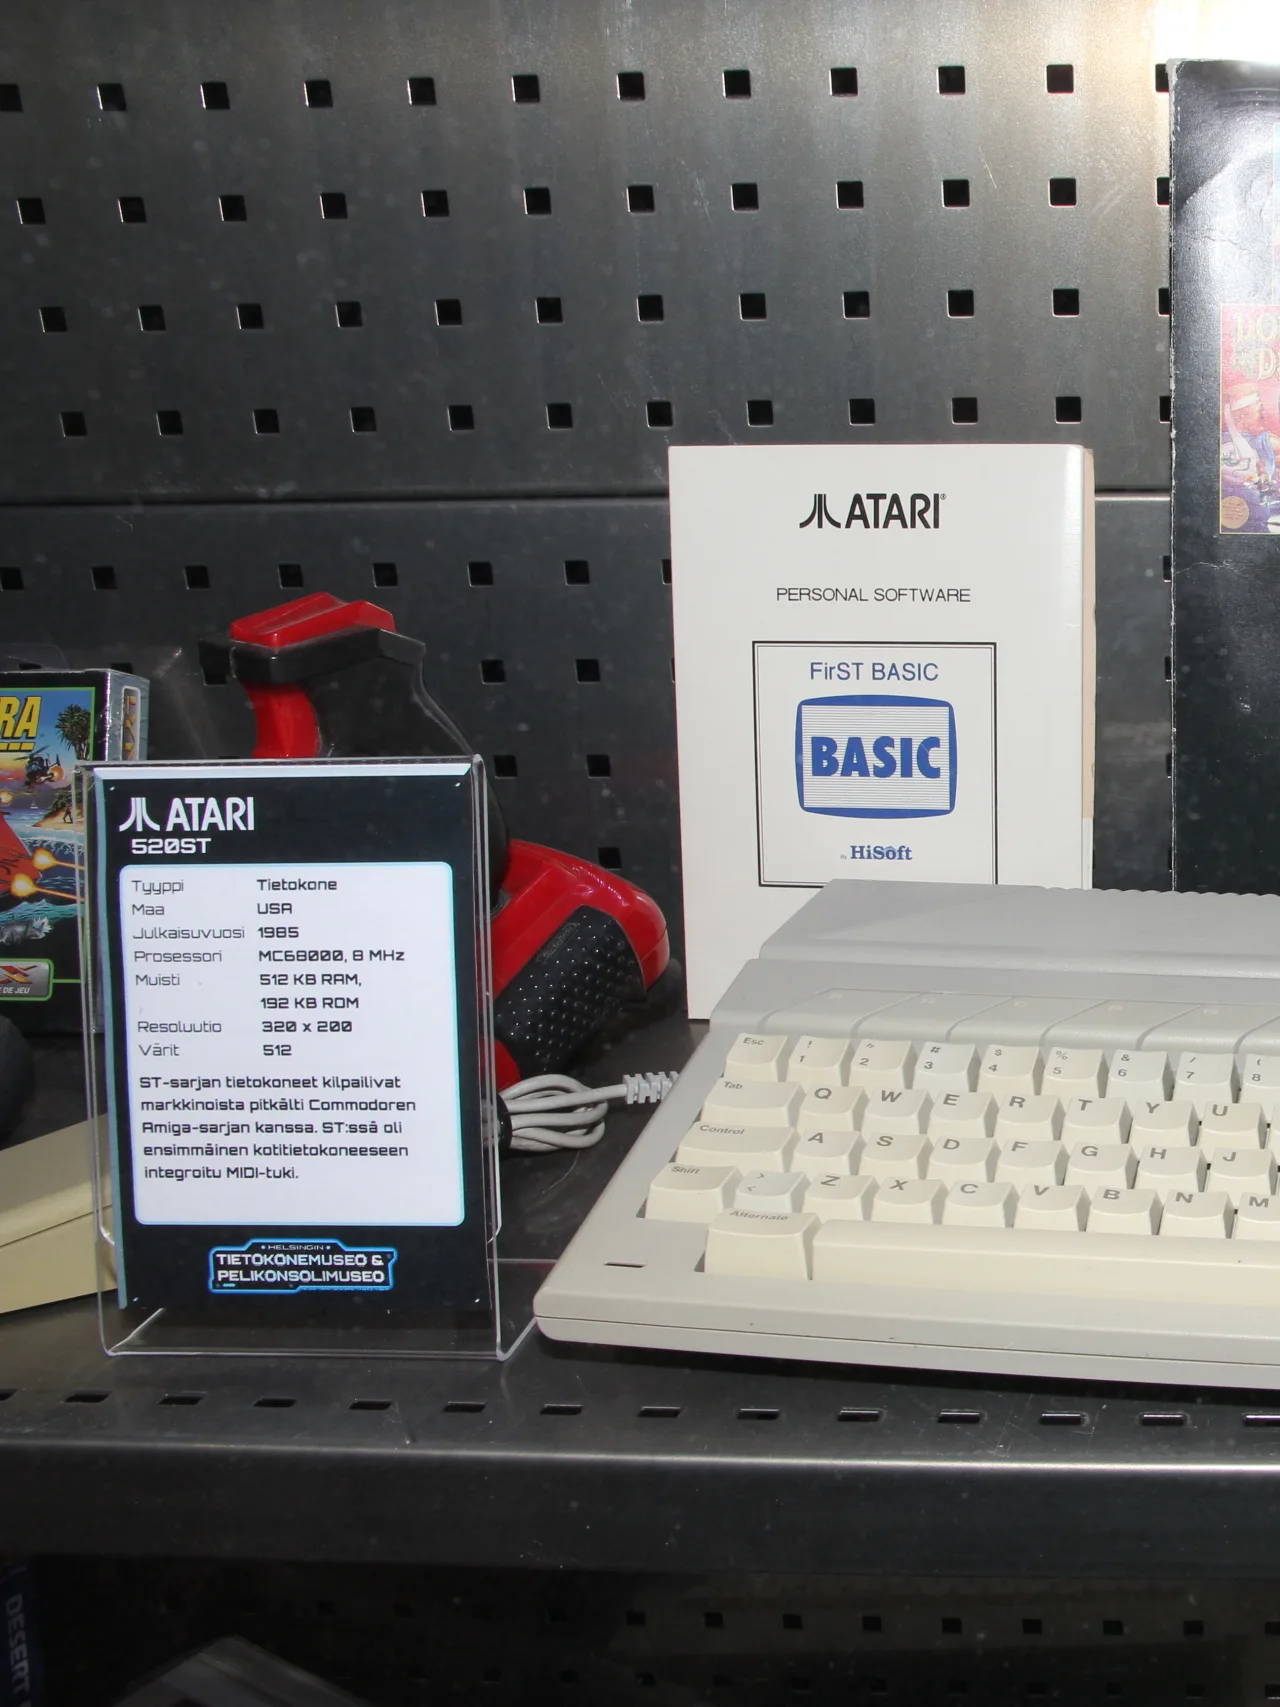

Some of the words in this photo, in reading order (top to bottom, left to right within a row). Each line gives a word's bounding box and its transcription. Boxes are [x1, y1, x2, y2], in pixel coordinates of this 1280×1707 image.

[777, 588, 868, 601] PERSONAL
[874, 588, 970, 602] SOFTWARE
[810, 662, 864, 680] FirST
[871, 663, 939, 681] BASIC
[811, 737, 940, 778] BASIC
[166, 797, 255, 831] ATARI
[132, 838, 212, 854] 520ST
[850, 845, 912, 860] HiSoft
[132, 880, 183, 895] Tyyppi
[257, 879, 337, 890] Tietokone
[132, 904, 164, 915] Maa
[258, 903, 292, 914] USA
[133, 927, 244, 939] Julkaisuvuosi
[258, 927, 299, 938] 1985
[134, 950, 222, 962] Prosessori
[259, 950, 347, 963] MC68000,
[353, 950, 363, 961] 8
[370, 950, 404, 961] MHz
[136, 974, 180, 986] Muisti
[260, 974, 288, 985] 512
[294, 974, 316, 985] KB
[322, 974, 361, 986] RAM,
[261, 998, 289, 1009] 192
[295, 997, 317, 1008] KB
[322, 997, 359, 1008] ROM
[138, 1021, 222, 1032] Resoluutio
[262, 1021, 297, 1032] 320
[303, 1023, 311, 1032] x
[317, 1021, 352, 1032] 200
[743, 1037, 764, 1045] Esc
[139, 1043, 179, 1056] Värit
[263, 1045, 292, 1056] 512
[860, 1058, 869, 1066] 2
[924, 1061, 933, 1069] 3
[989, 1064, 997, 1072] 4
[1187, 1071, 1194, 1079] 7
[140, 1077, 221, 1091] ST-sarjan
[226, 1076, 318, 1088] tietokoneet
[323, 1076, 401, 1091] kilpailivat
[725, 1081, 742, 1089] Tab
[814, 1088, 832, 1099] Q
[882, 1090, 902, 1102] W
[141, 1099, 244, 1110] markkinoista
[250, 1098, 304, 1113] pitkälti
[309, 1099, 415, 1111] Commodoren
[943, 1094, 960, 1106] E
[1009, 1096, 1025, 1108] R
[1078, 1099, 1093, 1111] T
[1146, 1102, 1160, 1114] Y
[1212, 1104, 1228, 1116] U
[142, 1121, 250, 1136] Amiga-sarjan
[255, 1121, 317, 1133] kanssa.
[322, 1121, 378, 1133] ST:ssä
[384, 1122, 402, 1133] oli
[700, 1125, 745, 1134] Control
[808, 1133, 823, 1143] A
[877, 1136, 893, 1146] S
[144, 1143, 248, 1156] ensimmäinen
[254, 1144, 408, 1156] kotitietokoneeseen
[943, 1139, 960, 1150] D
[1011, 1141, 1028, 1151] F
[1081, 1146, 1098, 1156] G
[1150, 1148, 1166, 1159] H
[1223, 1152, 1236, 1161] J
[145, 1167, 221, 1181] integroitu
[227, 1167, 298, 1178] MIDI-tuki.
[671, 1166, 700, 1174] Shift
[821, 1175, 840, 1186] Z
[890, 1180, 907, 1190] X
[960, 1184, 978, 1194] C
[1034, 1185, 1050, 1196] V
[1103, 1189, 1120, 1200] B
[1175, 1192, 1193, 1203] N
[1249, 1196, 1269, 1208] M
[730, 1211, 788, 1220] Alternate
[216, 1254, 367, 1266] TIETOKONEMUSEO
[372, 1255, 384, 1266] &
[217, 1270, 385, 1283] PELIKONSOLIMUSEO
[5, 1592, 31, 1694] DESERT
